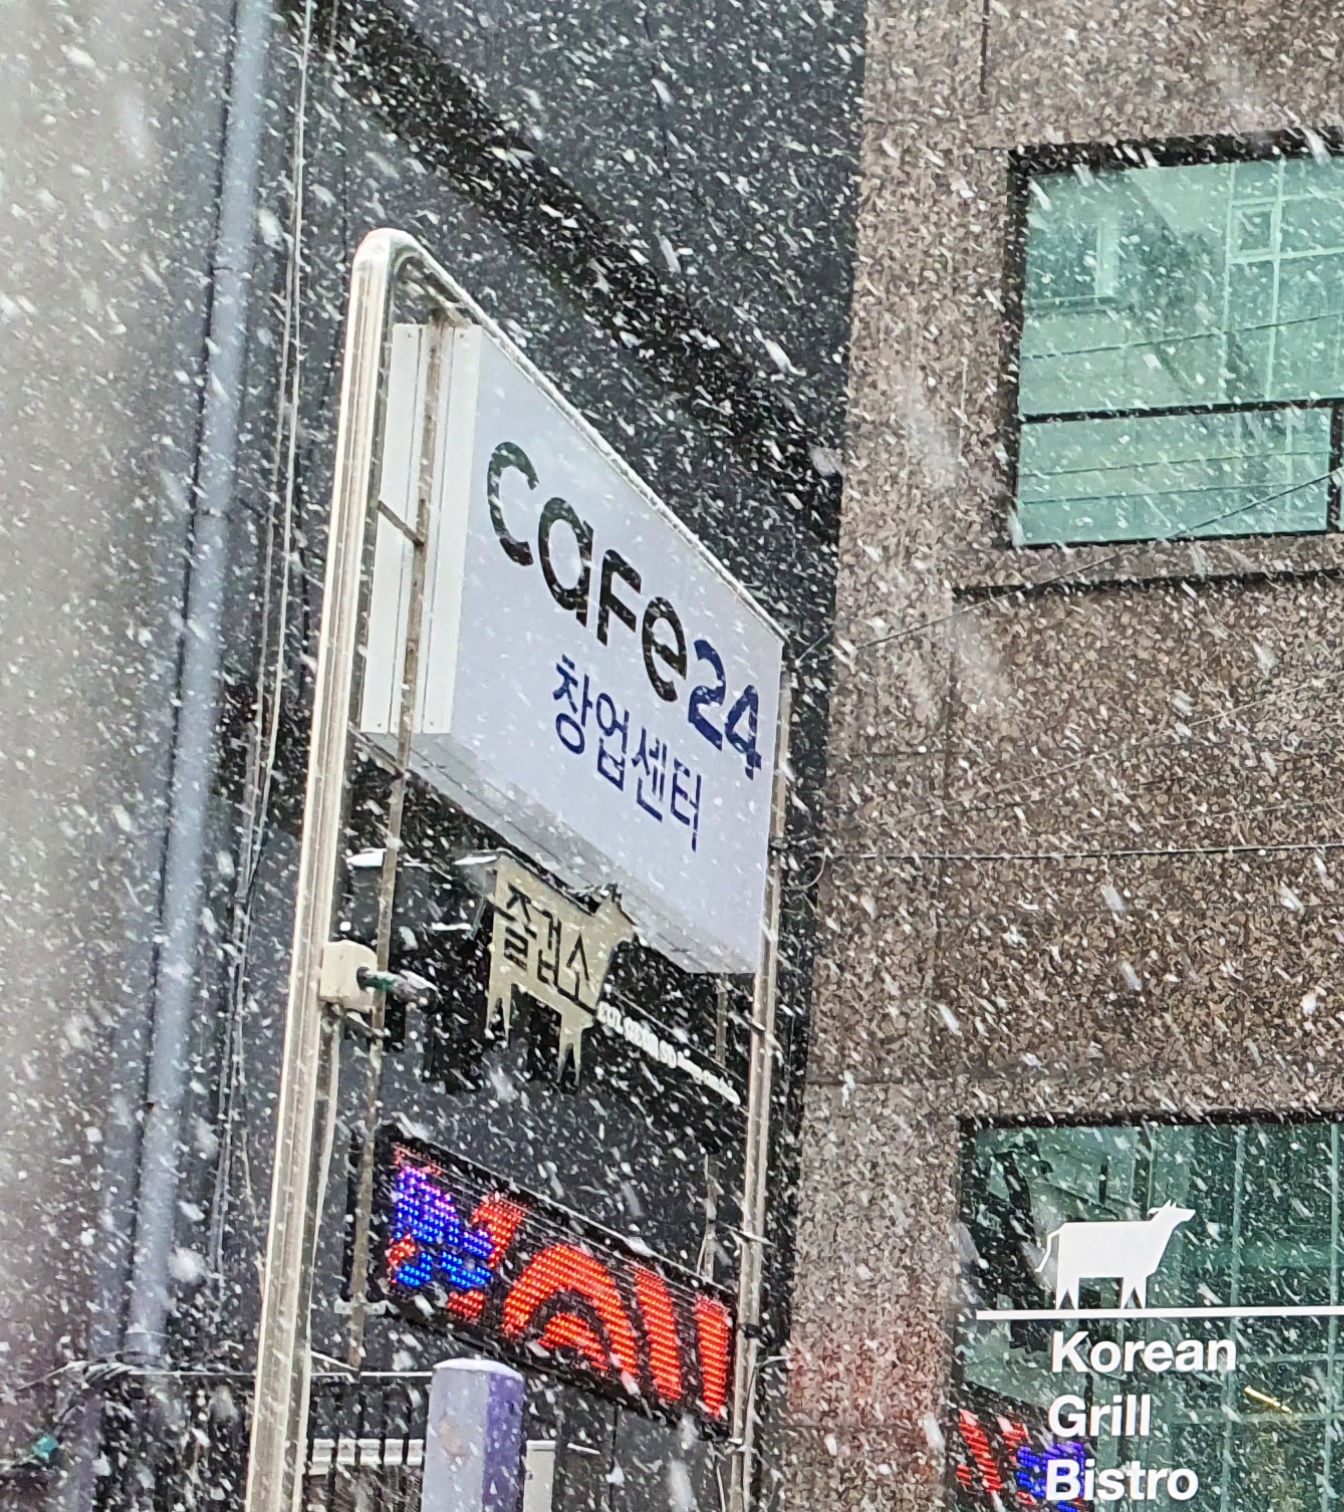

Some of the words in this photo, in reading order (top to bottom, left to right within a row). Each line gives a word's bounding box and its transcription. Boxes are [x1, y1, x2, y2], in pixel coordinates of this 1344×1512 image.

[552, 654, 703, 853] 창업센터
[1051, 1331, 1238, 1374] Korean
[1047, 1394, 1152, 1438] Grill
[1044, 1459, 1199, 1503] Bistro
